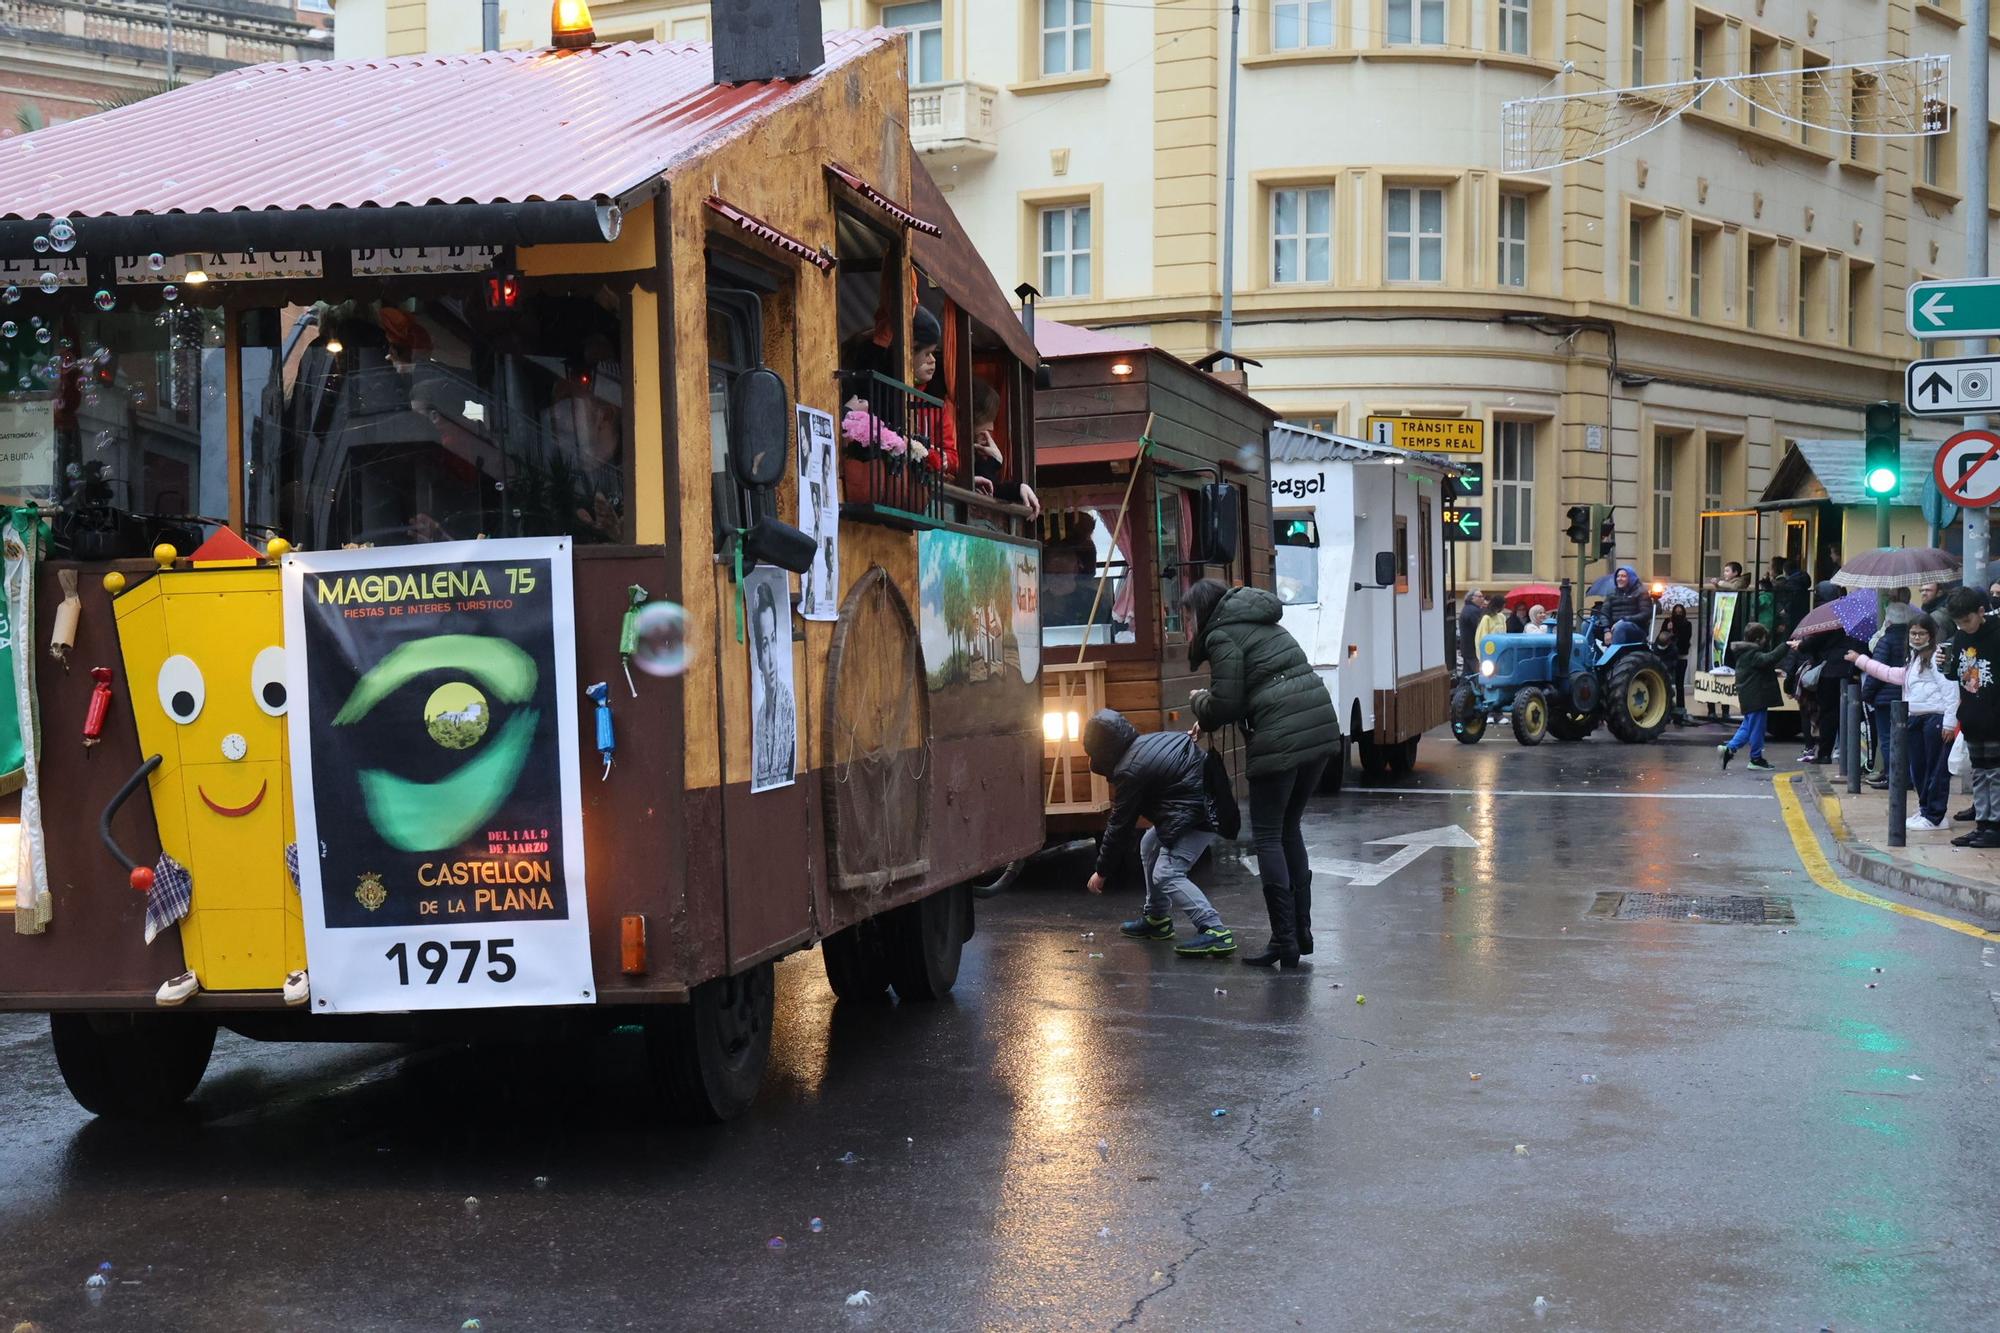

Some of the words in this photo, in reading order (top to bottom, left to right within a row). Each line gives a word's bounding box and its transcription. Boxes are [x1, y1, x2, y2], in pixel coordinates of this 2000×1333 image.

[1458, 424, 1474, 434] EN
[1401, 437, 1441, 448] TEMPS
[1446, 438, 1476, 449] REAL
[318, 569, 491, 605] MAGDALENA
[505, 568, 536, 594] 75
[344, 606, 385, 619] FIESTAS
[389, 606, 404, 616] DE
[408, 603, 451, 614] INTERES
[456, 599, 513, 612] TURISTICO
[488, 830, 510, 841] DEL
[522, 829, 538, 840] AL
[540, 828, 548, 839] 9
[488, 843, 504, 854] DE
[507, 842, 549, 854] MARZO
[417, 860, 551, 886] CASTELLON
[420, 900, 438, 915] DE
[448, 899, 465, 913] LA
[475, 888, 554, 912] PLANA
[385, 938, 517, 985] 1975
